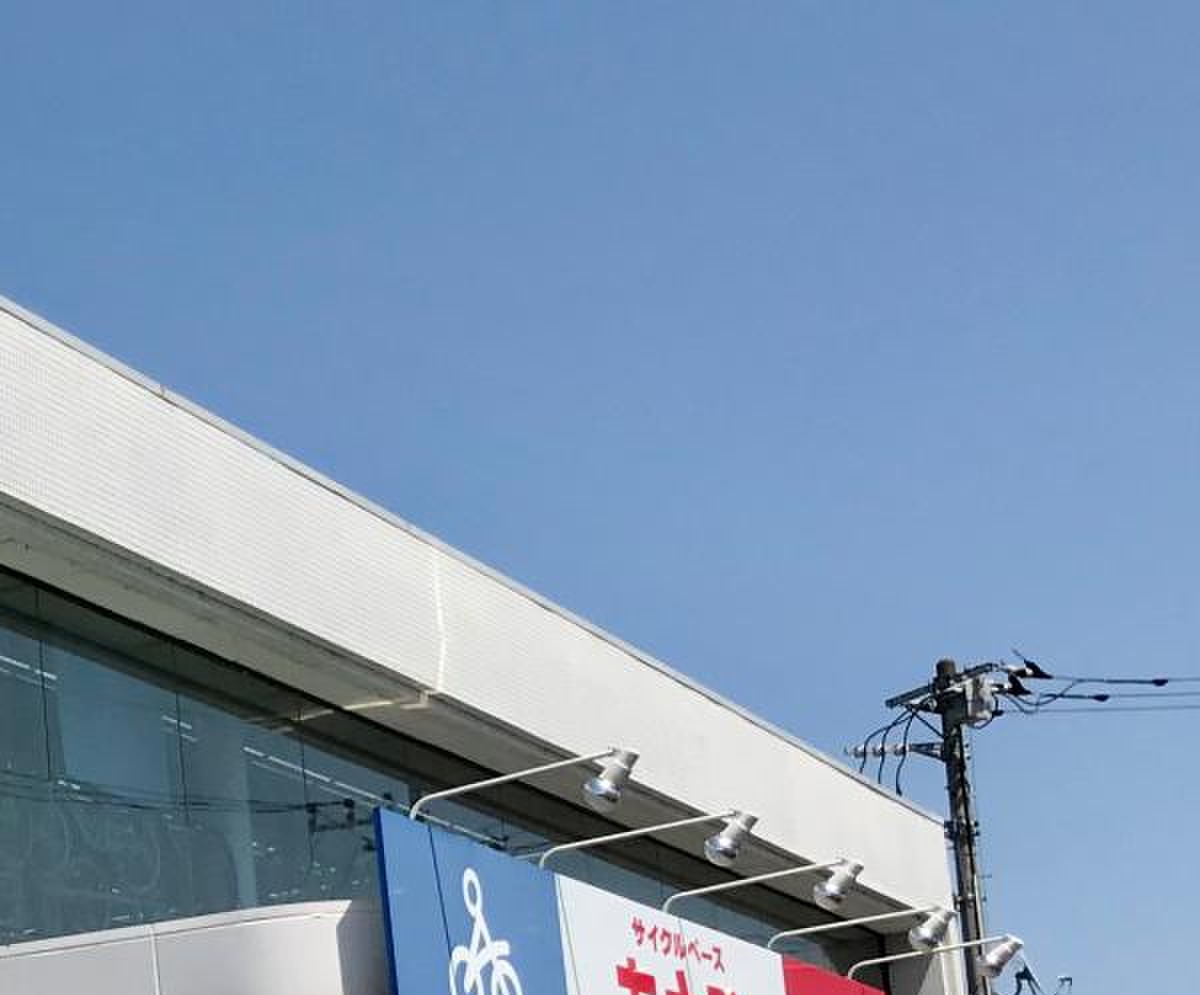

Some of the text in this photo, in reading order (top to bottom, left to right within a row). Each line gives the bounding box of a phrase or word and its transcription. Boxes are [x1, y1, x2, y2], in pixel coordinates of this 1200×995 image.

[631, 916, 726, 974] サイクルベース
